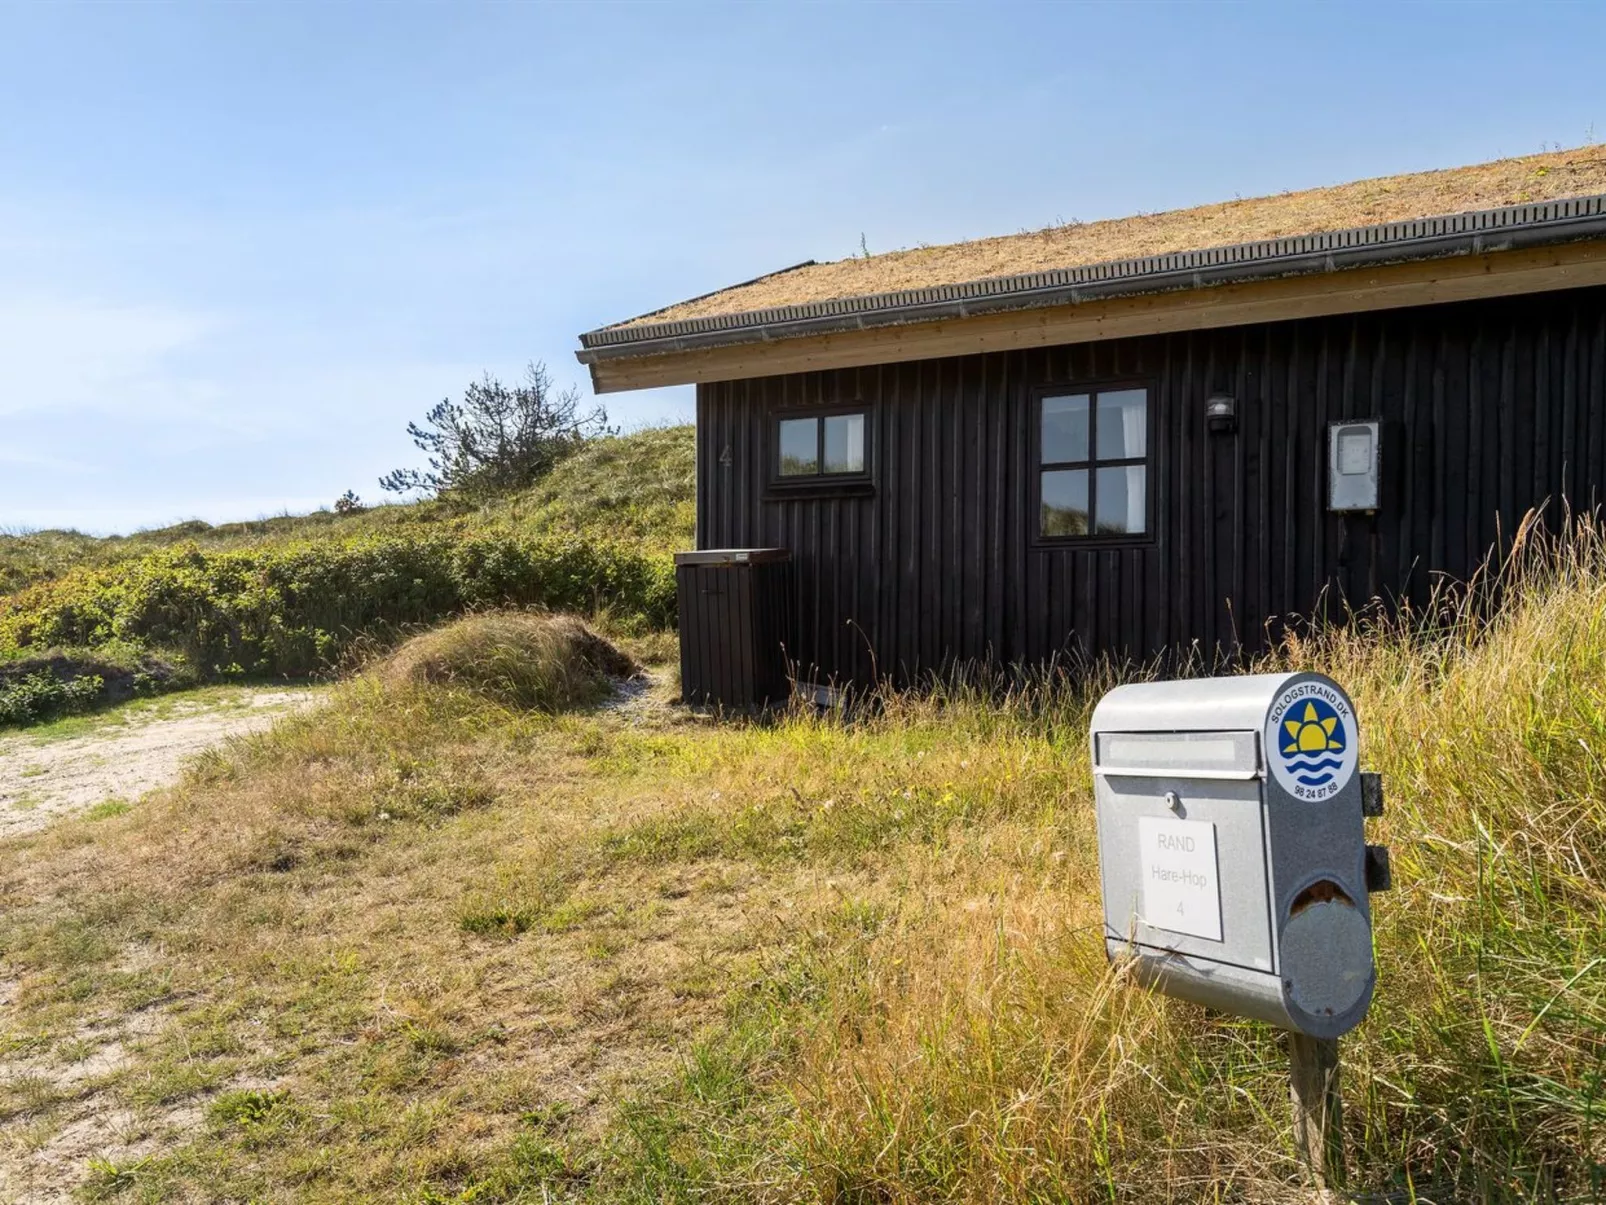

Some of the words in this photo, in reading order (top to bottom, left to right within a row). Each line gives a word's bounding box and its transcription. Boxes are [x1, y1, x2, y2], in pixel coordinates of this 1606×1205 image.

[719, 445, 732, 467] 4
[1271, 685, 1349, 724] SOLOGSTRAND.DK
[1295, 785, 1304, 797] 98
[1305, 789, 1316, 799] 24
[1317, 788, 1326, 798] 87
[1157, 833, 1195, 852] RAND
[1151, 865, 1207, 888] Hare-Hop
[1176, 901, 1184, 916] 4
